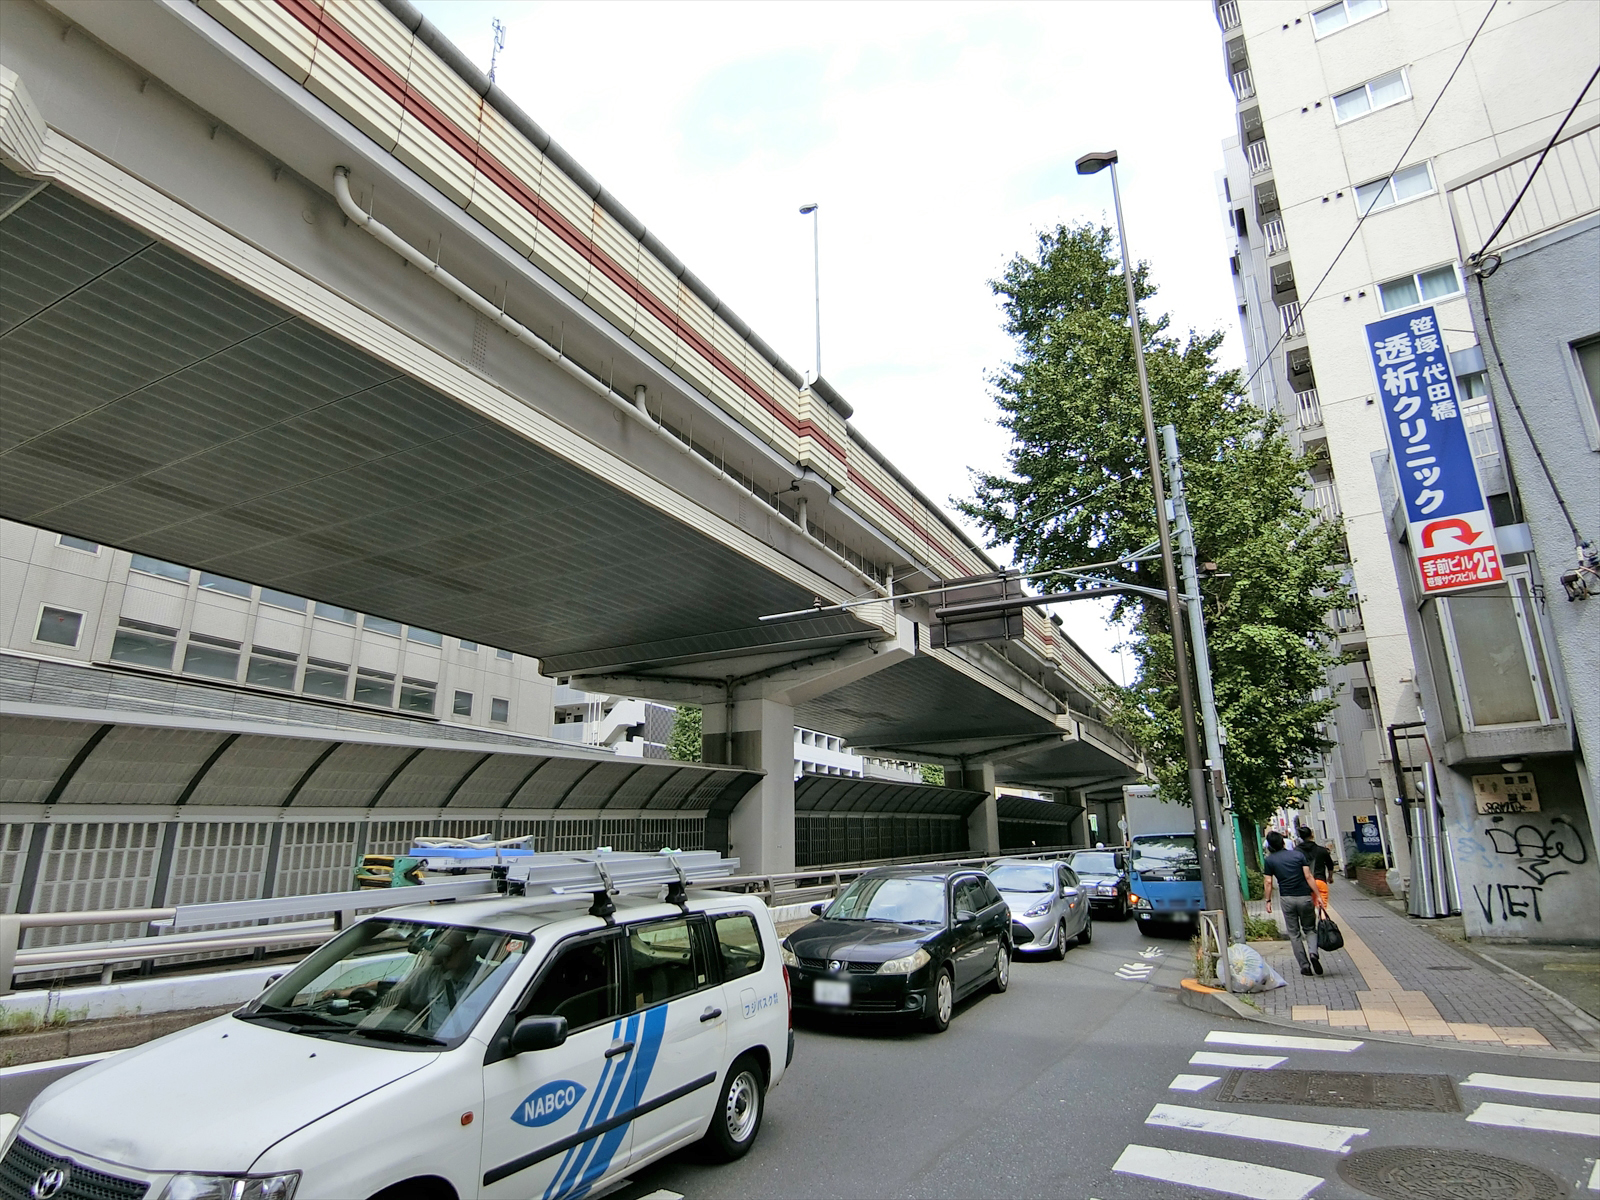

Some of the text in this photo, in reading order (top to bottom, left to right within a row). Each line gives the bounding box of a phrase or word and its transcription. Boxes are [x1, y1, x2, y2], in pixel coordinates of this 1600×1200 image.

[1410, 316, 1457, 422] 笹塚・代田橋
[1374, 333, 1445, 515] 透析クリニック
[1423, 555, 1473, 576] 手前ビル
[1426, 571, 1476, 587] 笹塚サウスビル
[1473, 550, 1497, 579] 2F
[1473, 883, 1543, 925] VIET
[524, 1085, 576, 1122] NABCO
